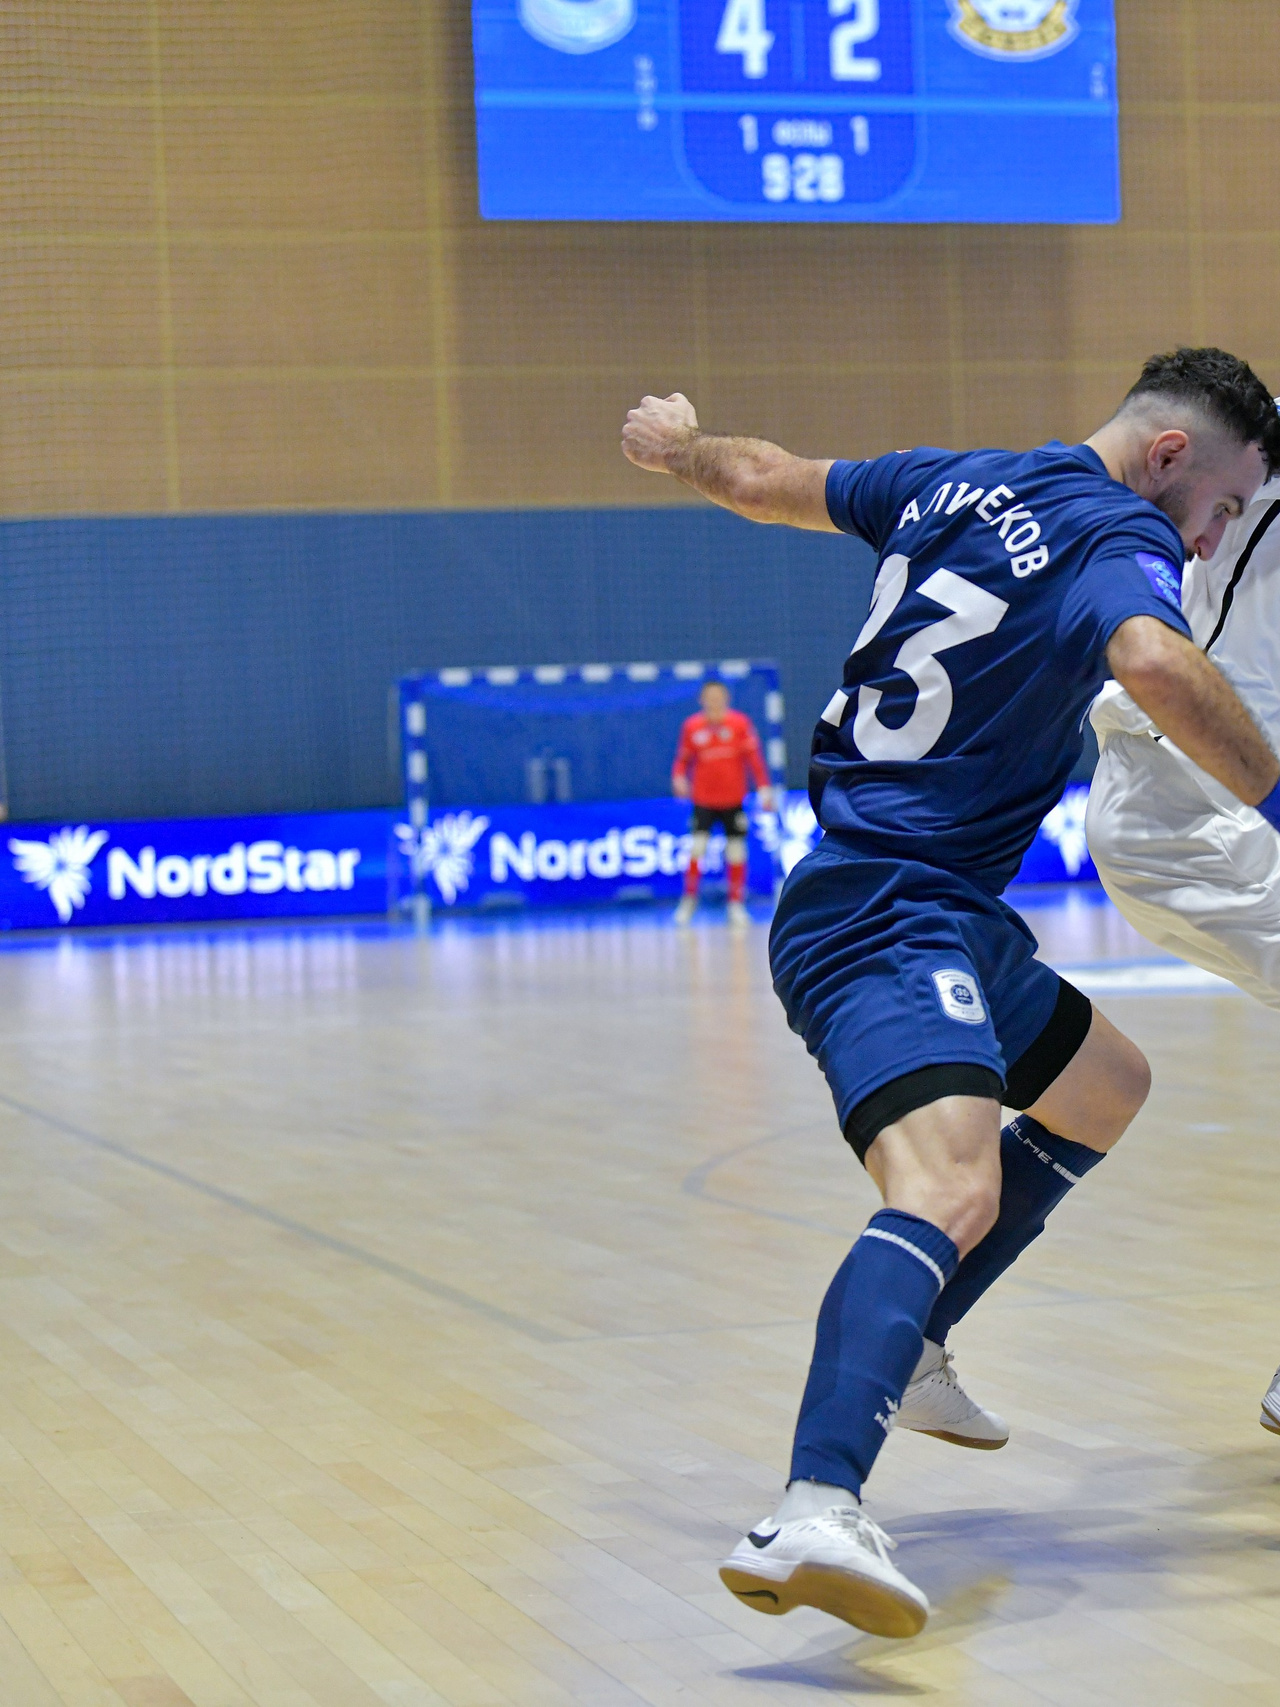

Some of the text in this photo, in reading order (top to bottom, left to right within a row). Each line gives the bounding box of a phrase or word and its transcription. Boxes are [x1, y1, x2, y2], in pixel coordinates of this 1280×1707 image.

[716, 0, 882, 81] 4 2
[739, 113, 758, 153] 1
[850, 115, 869, 155] 1
[107, 840, 361, 900] NordStar
[1009, 1121, 1053, 1164] ELME
